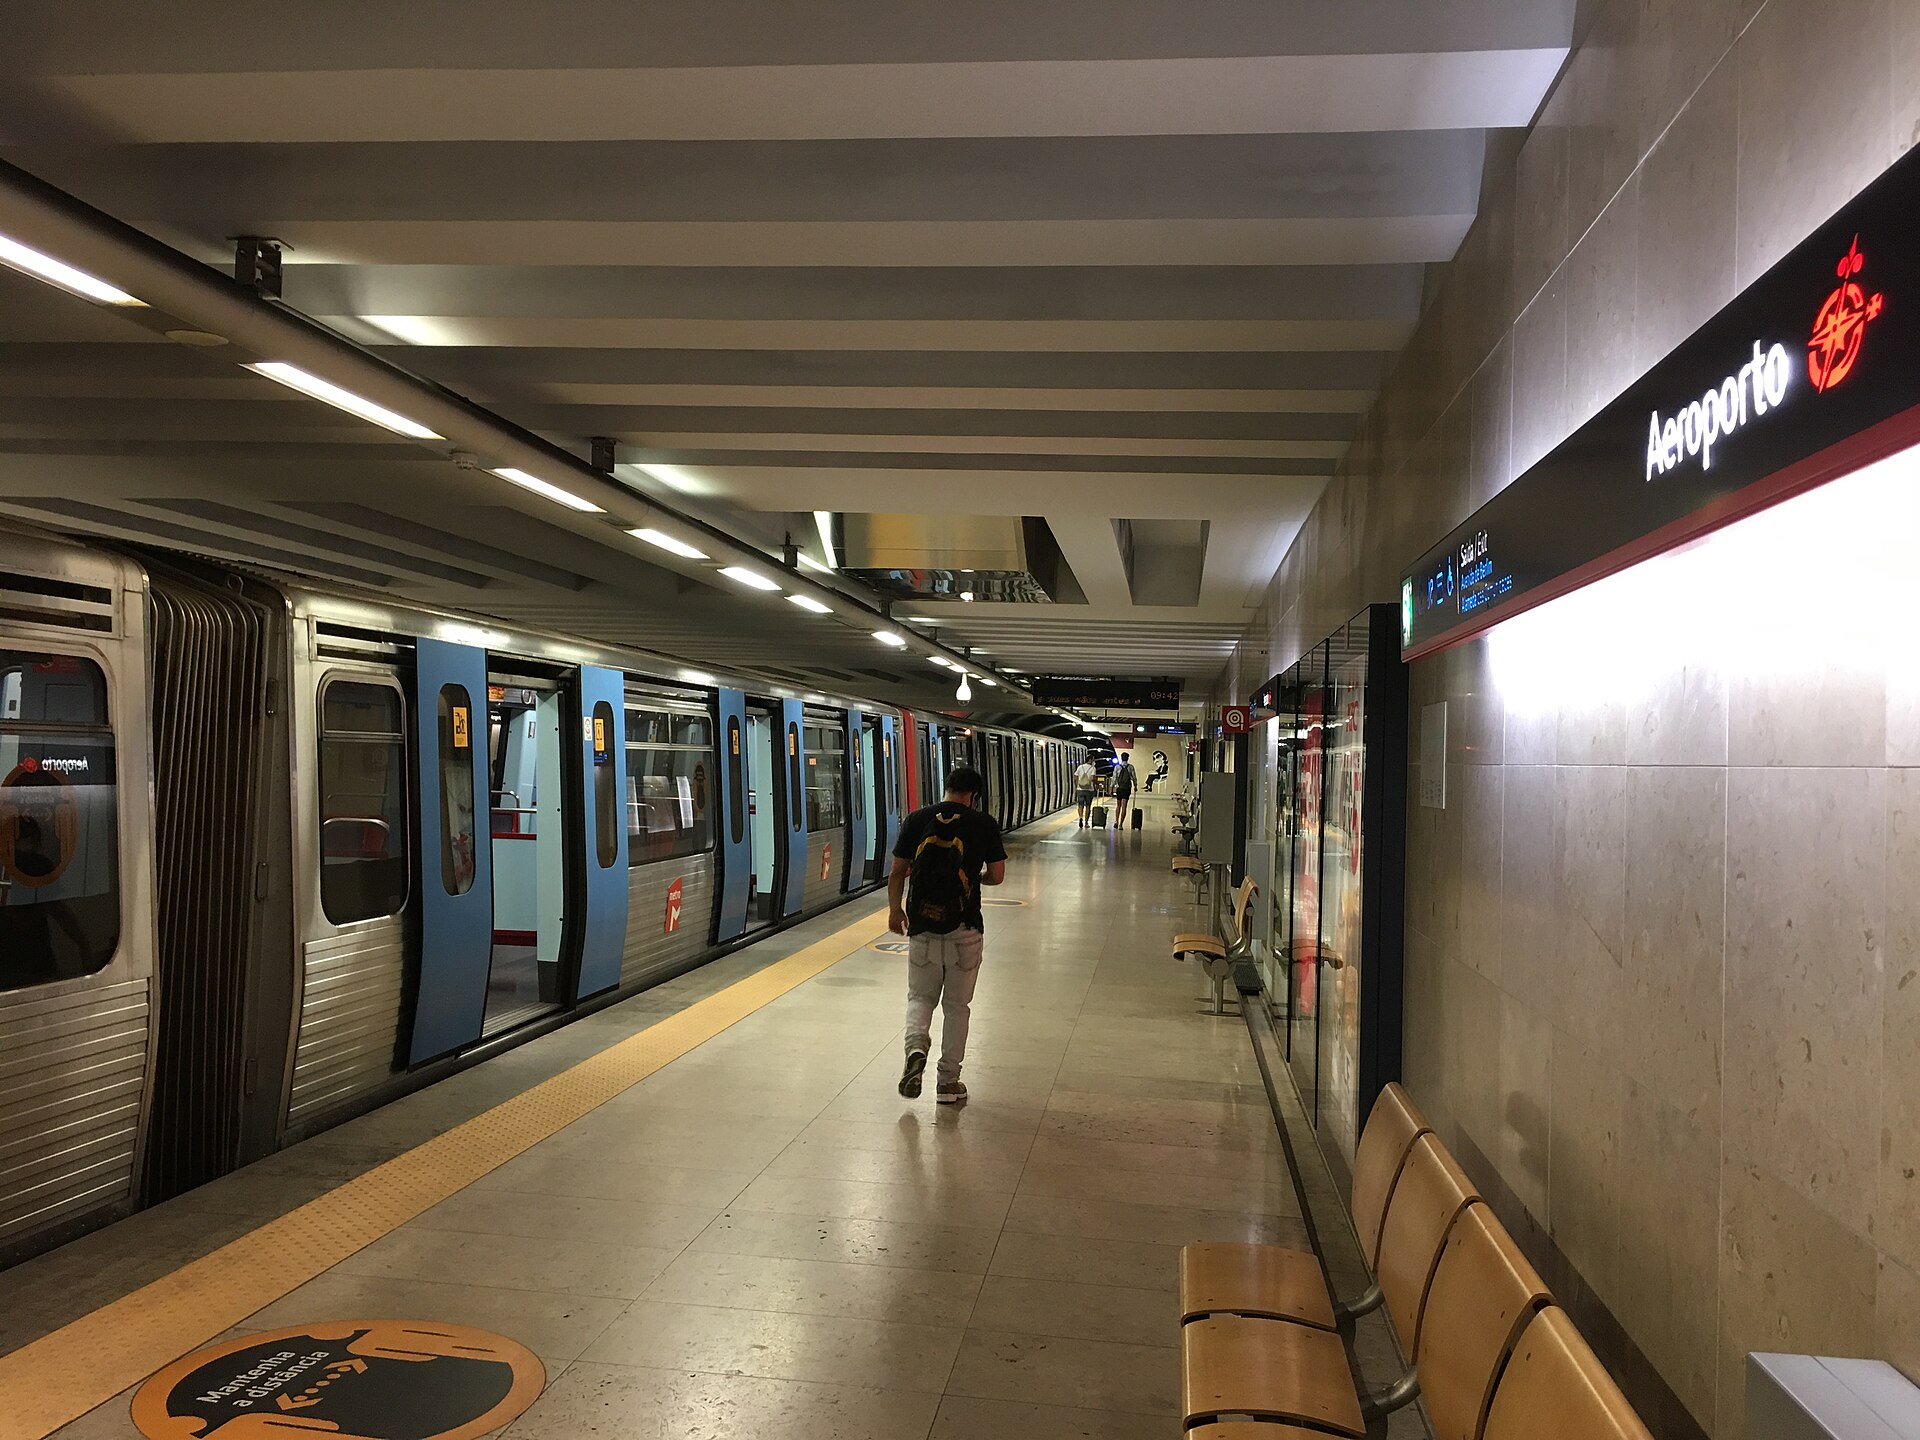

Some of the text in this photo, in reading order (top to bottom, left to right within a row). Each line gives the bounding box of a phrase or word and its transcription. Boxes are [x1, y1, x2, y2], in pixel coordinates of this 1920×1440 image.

[1646, 339, 1790, 482] Aeroporto
[1150, 691, 1179, 701] 09:42
[669, 890, 681, 901] metro
[196, 1350, 296, 1403] Mantenha
[232, 1351, 330, 1408] a distância
